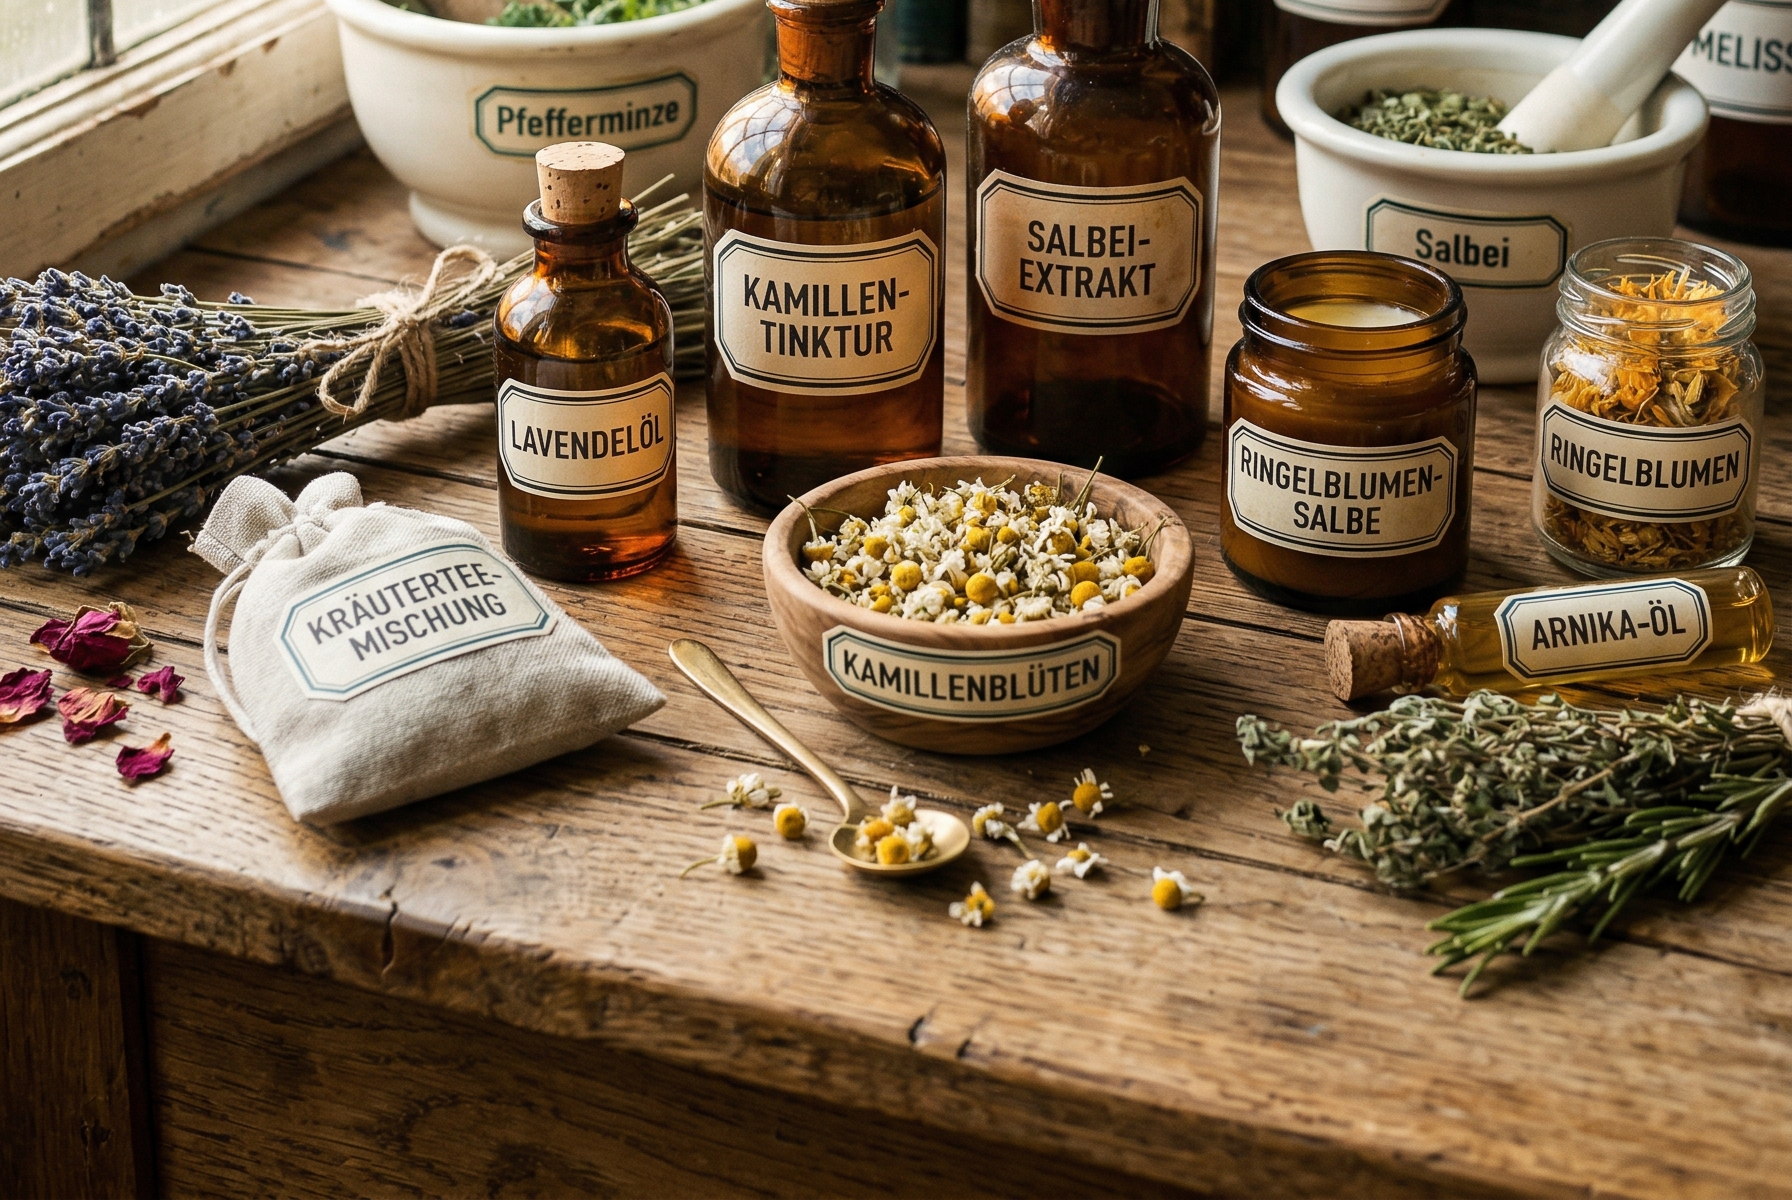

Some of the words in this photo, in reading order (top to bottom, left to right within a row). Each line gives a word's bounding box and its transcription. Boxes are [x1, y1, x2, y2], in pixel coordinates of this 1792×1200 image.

[497, 100, 679, 138] Pfefferminze
[1027, 220, 1150, 258] SALBEI-
[1415, 228, 1509, 268] Salbei
[744, 273, 910, 317] KAMILLEN-
[1019, 257, 1156, 299] EXTRAKT
[760, 319, 893, 359] TINKTUR
[511, 412, 664, 460] LAVENDELÖL
[1240, 444, 1443, 500] RINGELBLUMEN-
[1550, 432, 1740, 489] RINGELBLUMEN
[1293, 501, 1381, 535] SALBE
[306, 563, 503, 645] KRÄUTERTEE-
[348, 593, 507, 661] MISCHUNG
[1532, 599, 1686, 650] ARNIKA-ÖL
[843, 649, 1100, 702] KAMILLENBLÜTEN
